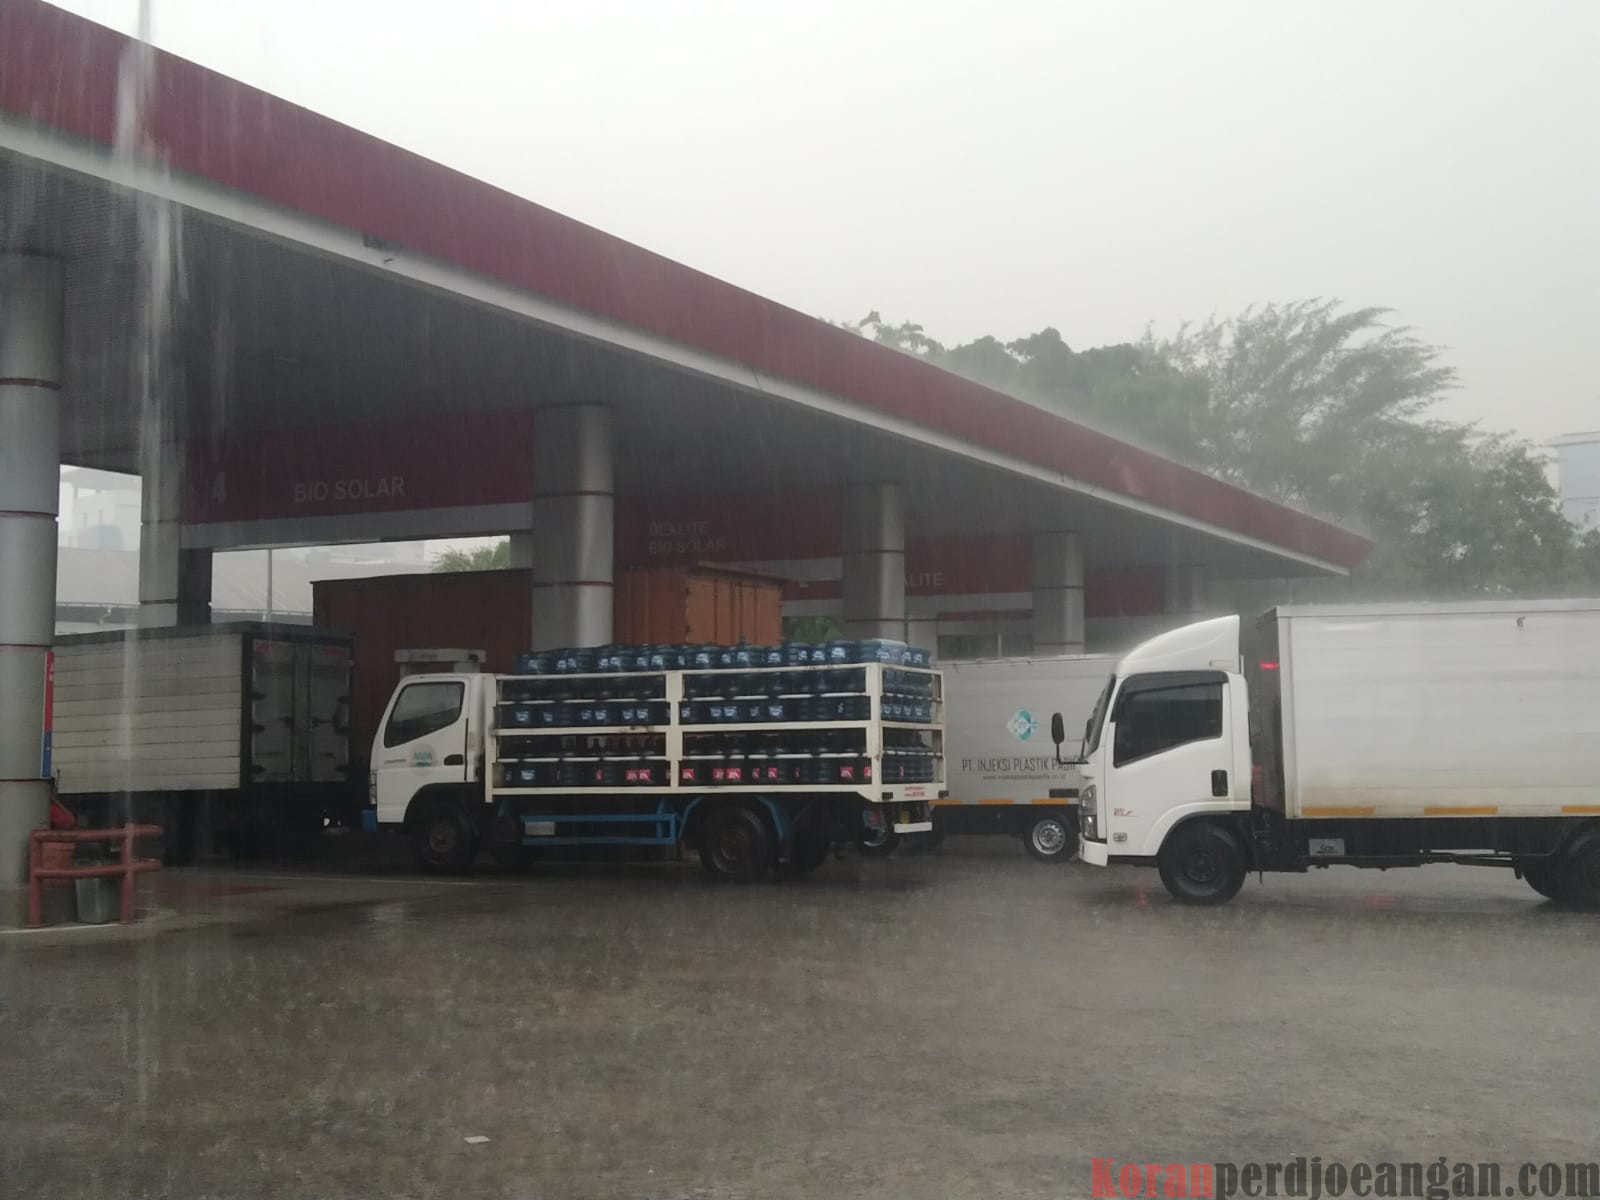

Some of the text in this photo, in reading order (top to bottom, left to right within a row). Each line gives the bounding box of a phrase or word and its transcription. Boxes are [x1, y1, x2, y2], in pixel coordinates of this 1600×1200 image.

[294, 476, 406, 503] BIO SOLAR
[904, 572, 944, 588] LITE
[977, 759, 1011, 772] INJEKSI
[1013, 758, 1049, 772] PLASTIK
